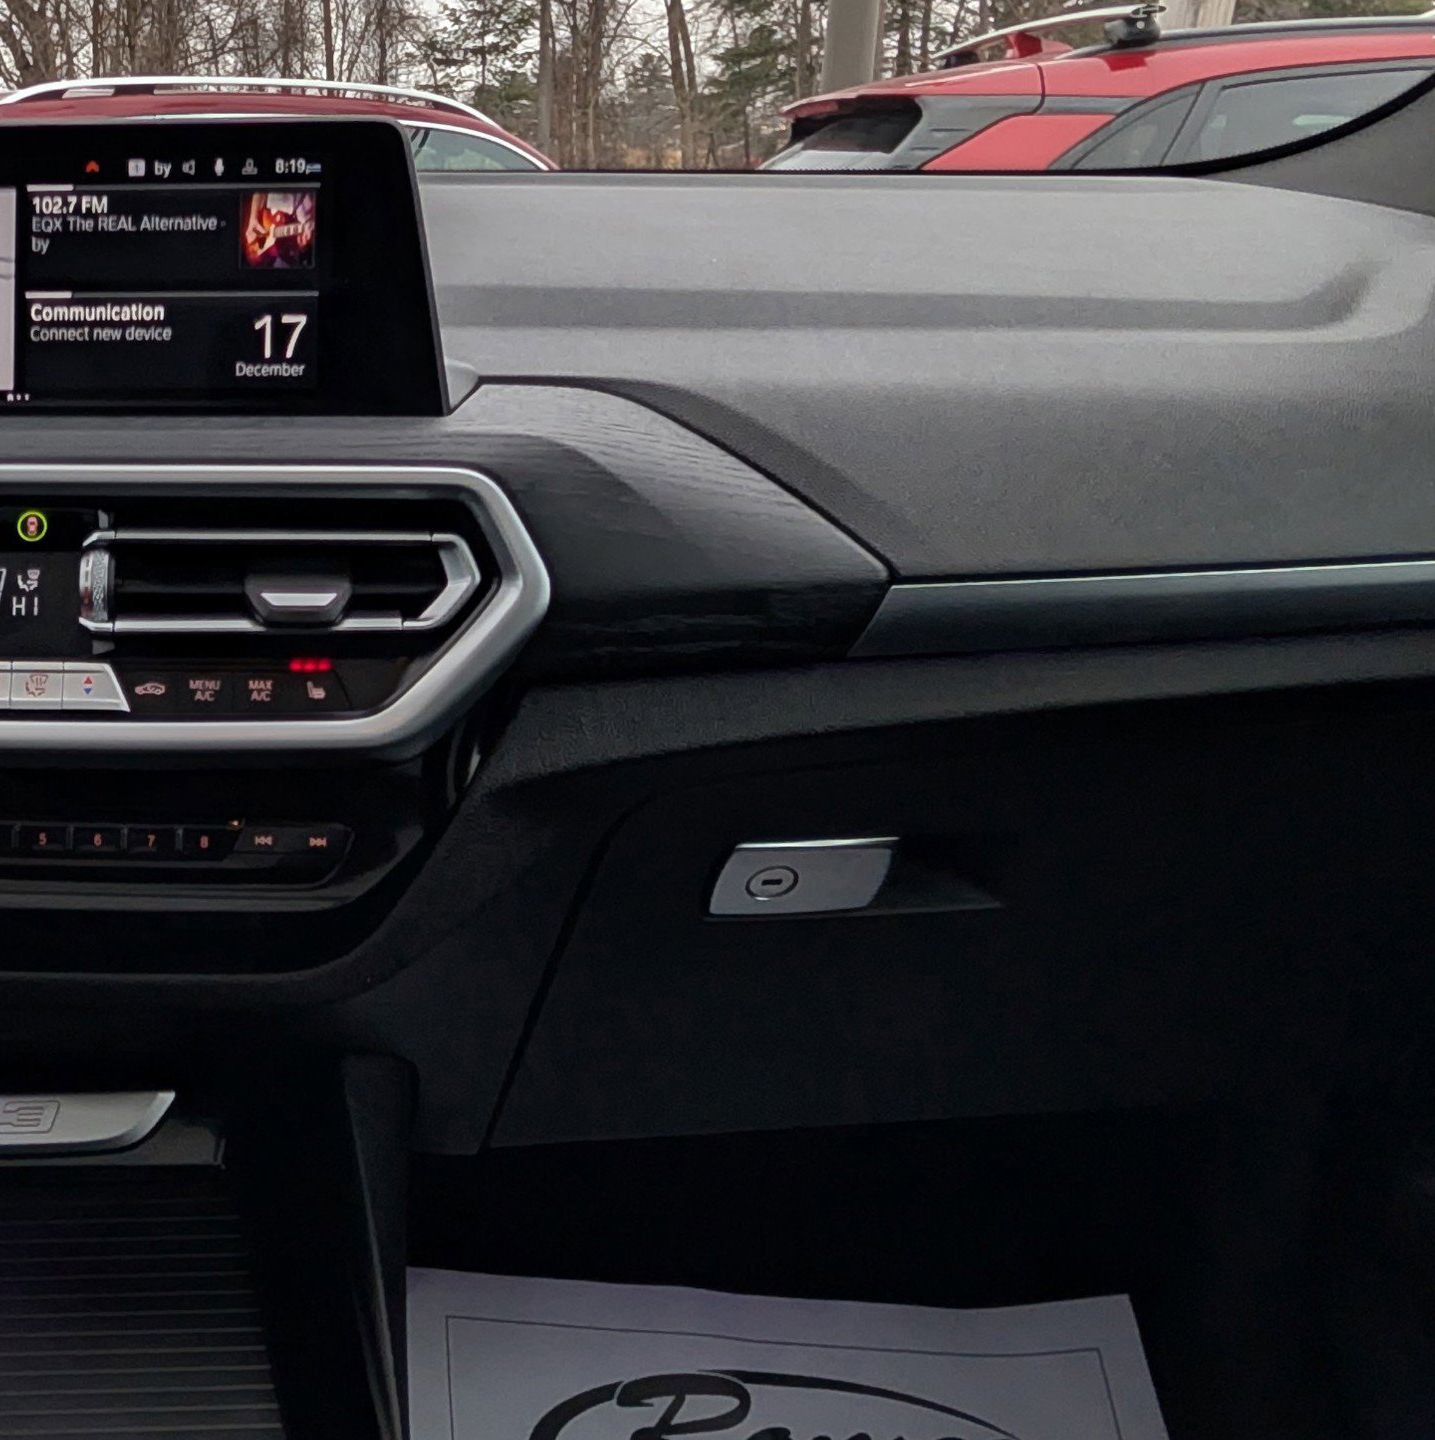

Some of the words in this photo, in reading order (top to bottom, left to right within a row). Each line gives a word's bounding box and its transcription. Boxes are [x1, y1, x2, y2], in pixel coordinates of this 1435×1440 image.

[275, 159, 306, 174] 8:19
[32, 195, 76, 215] 102.7
[82, 195, 109, 214] FM
[67, 216, 94, 232] The
[98, 215, 136, 232] REAL
[140, 214, 218, 231] Alternative
[31, 235, 50, 255] by
[30, 302, 166, 322] Communication
[30, 325, 90, 342] Connect
[93, 328, 122, 342] new
[125, 325, 173, 342] device
[254, 314, 308, 359] 17
[235, 361, 306, 377] December
[12, 595, 39, 617] HI
[189, 679, 221, 691] MENU
[248, 679, 274, 691] MAX
[194, 691, 216, 703] A/C
[251, 691, 272, 703] A/C
